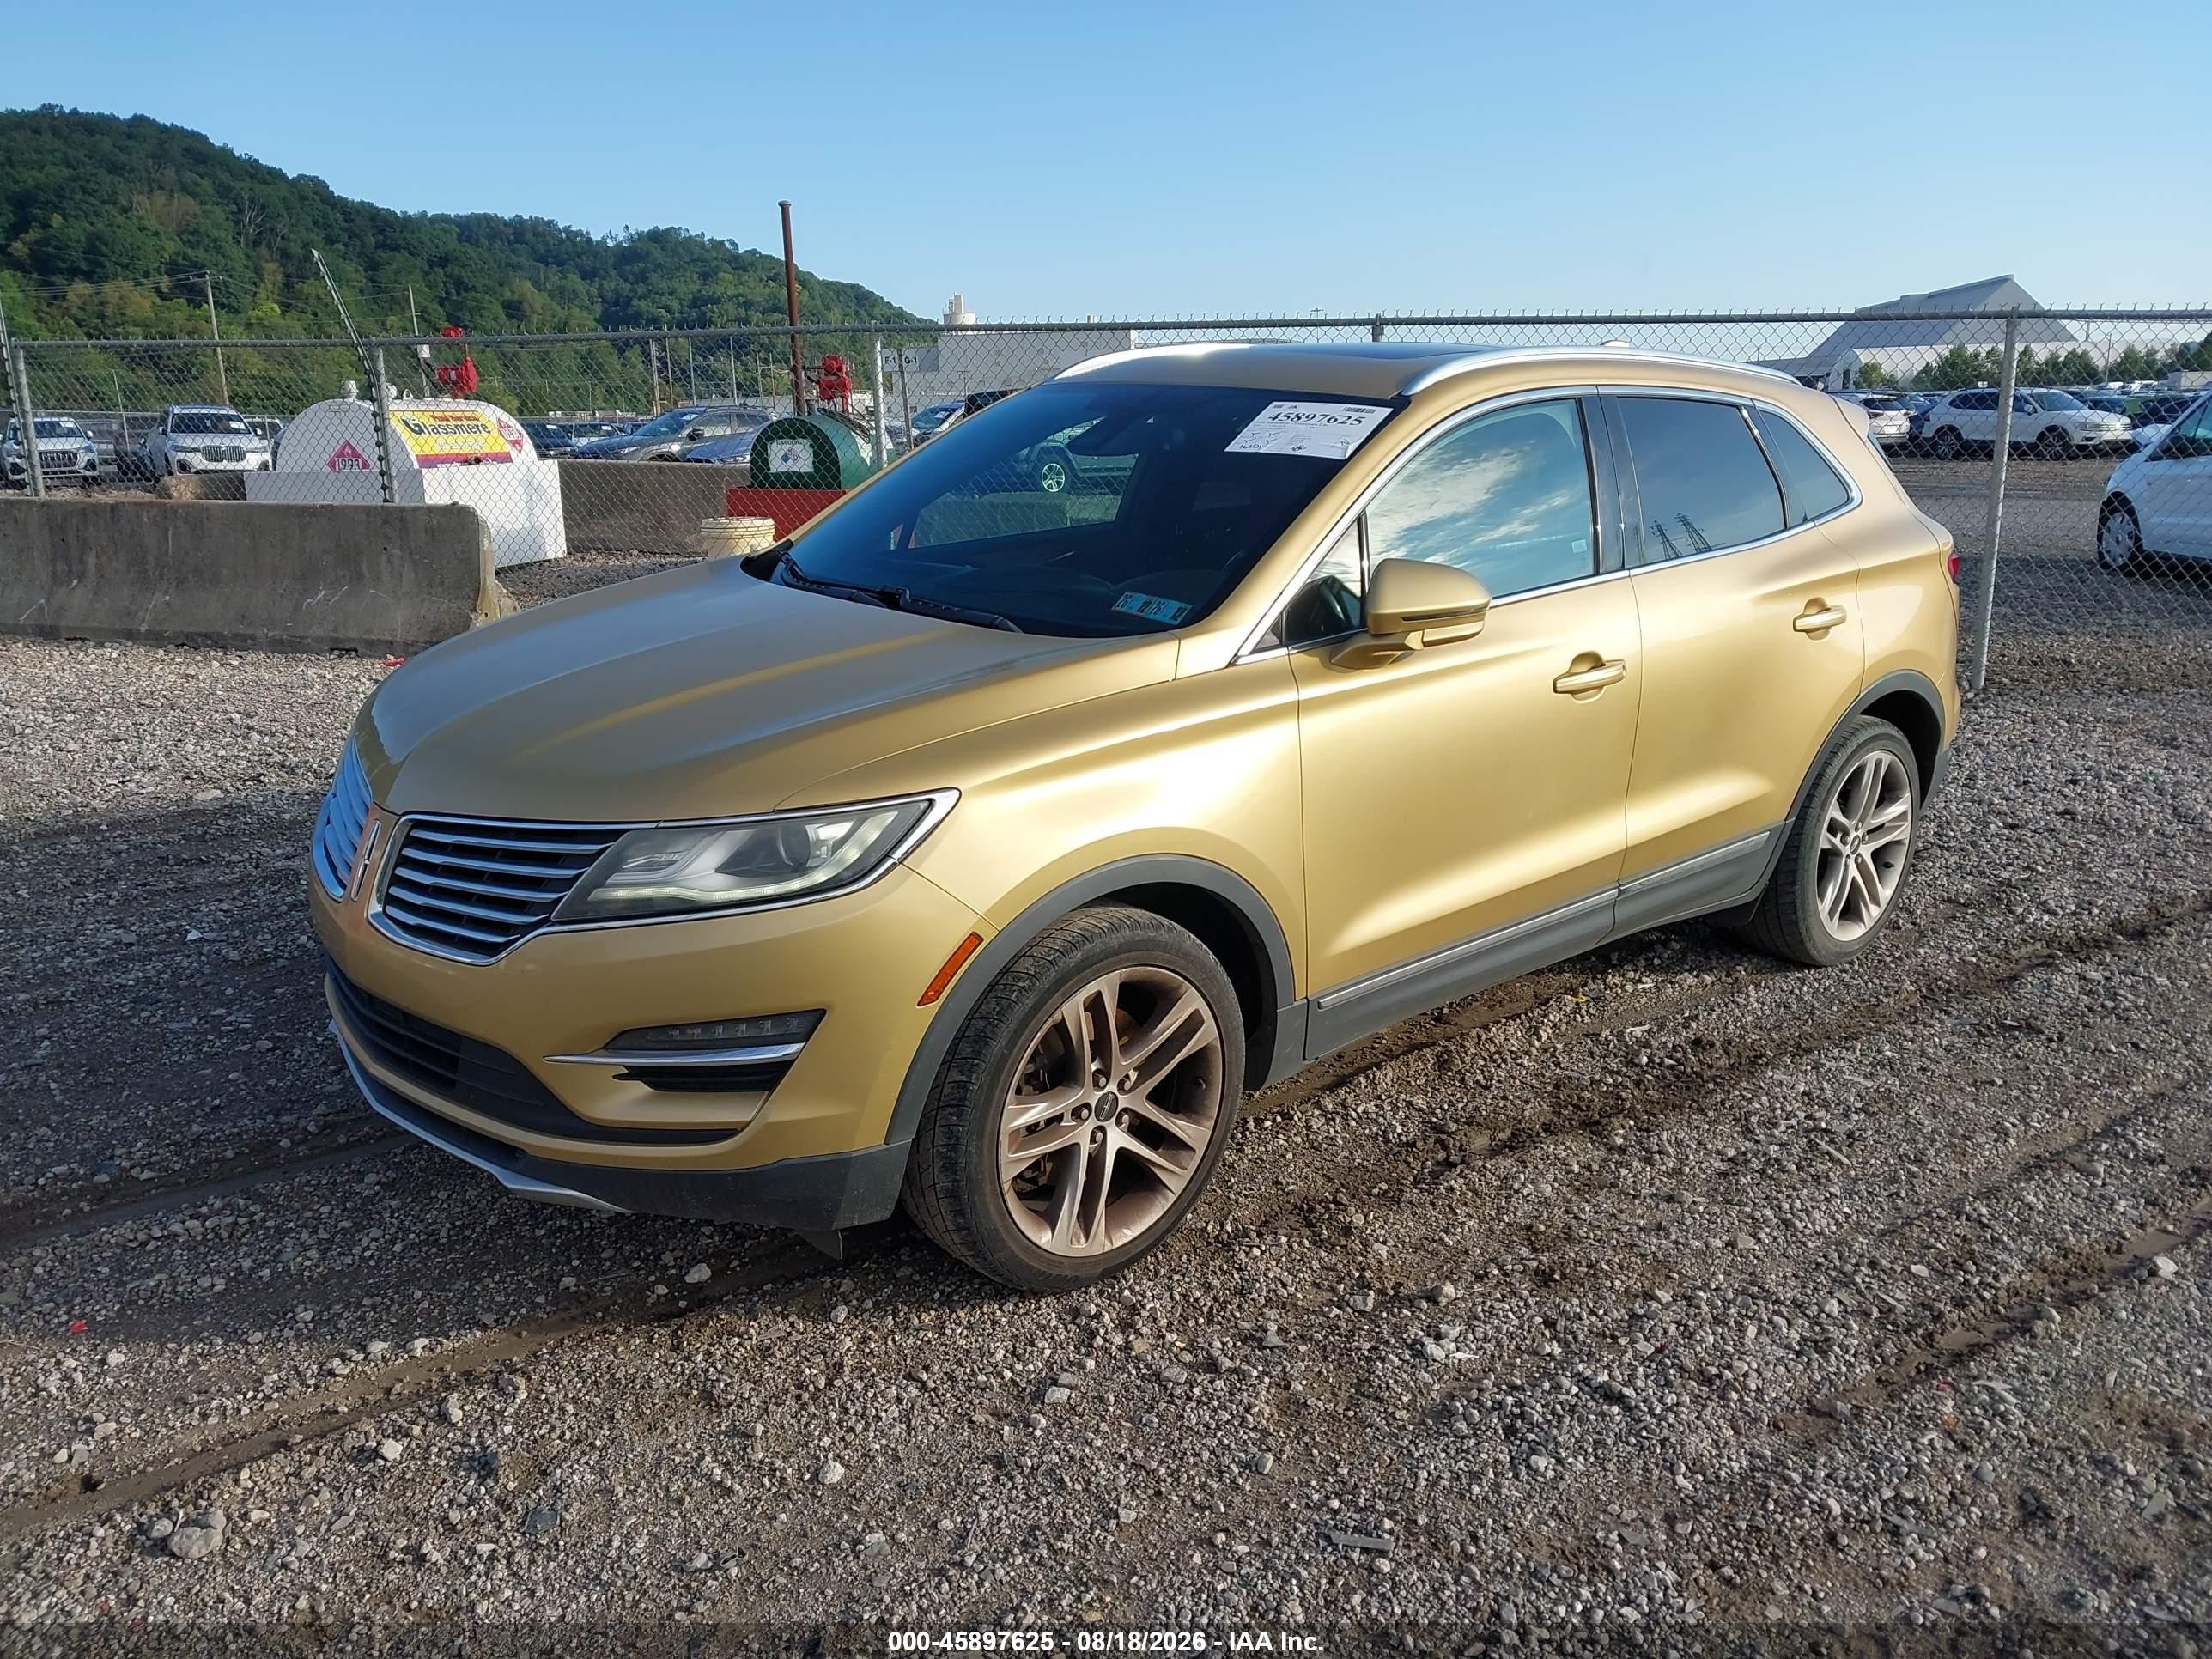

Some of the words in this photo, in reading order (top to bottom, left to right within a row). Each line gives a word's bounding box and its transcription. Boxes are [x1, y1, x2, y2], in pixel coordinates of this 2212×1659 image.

[884, 356, 897, 365] F-1
[904, 356, 918, 365] G-1
[1268, 411, 1368, 427] 45897625
[400, 416, 492, 435] Glassmere
